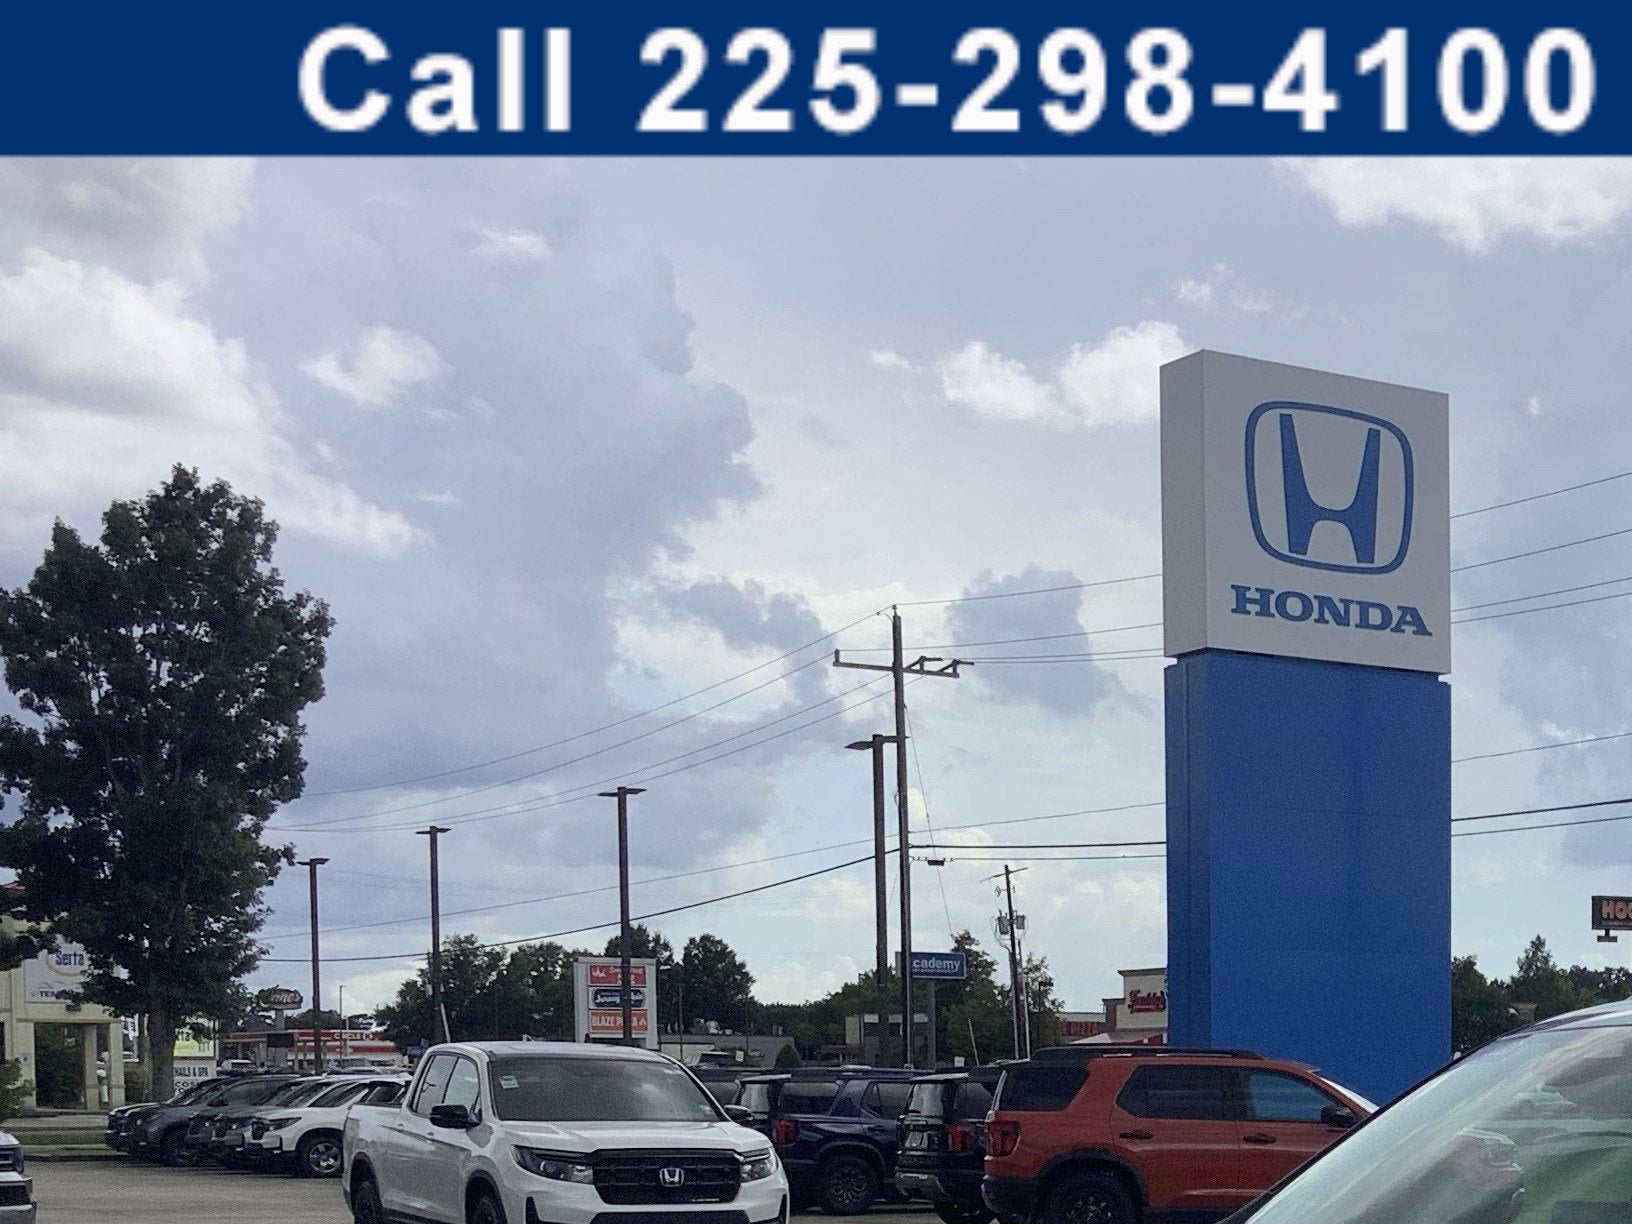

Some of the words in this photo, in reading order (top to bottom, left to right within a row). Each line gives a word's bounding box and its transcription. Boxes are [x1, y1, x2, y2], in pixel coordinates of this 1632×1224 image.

[1230, 583, 1433, 637] HONDA
[56, 951, 84, 966] Serta
[912, 957, 960, 971] cademy
